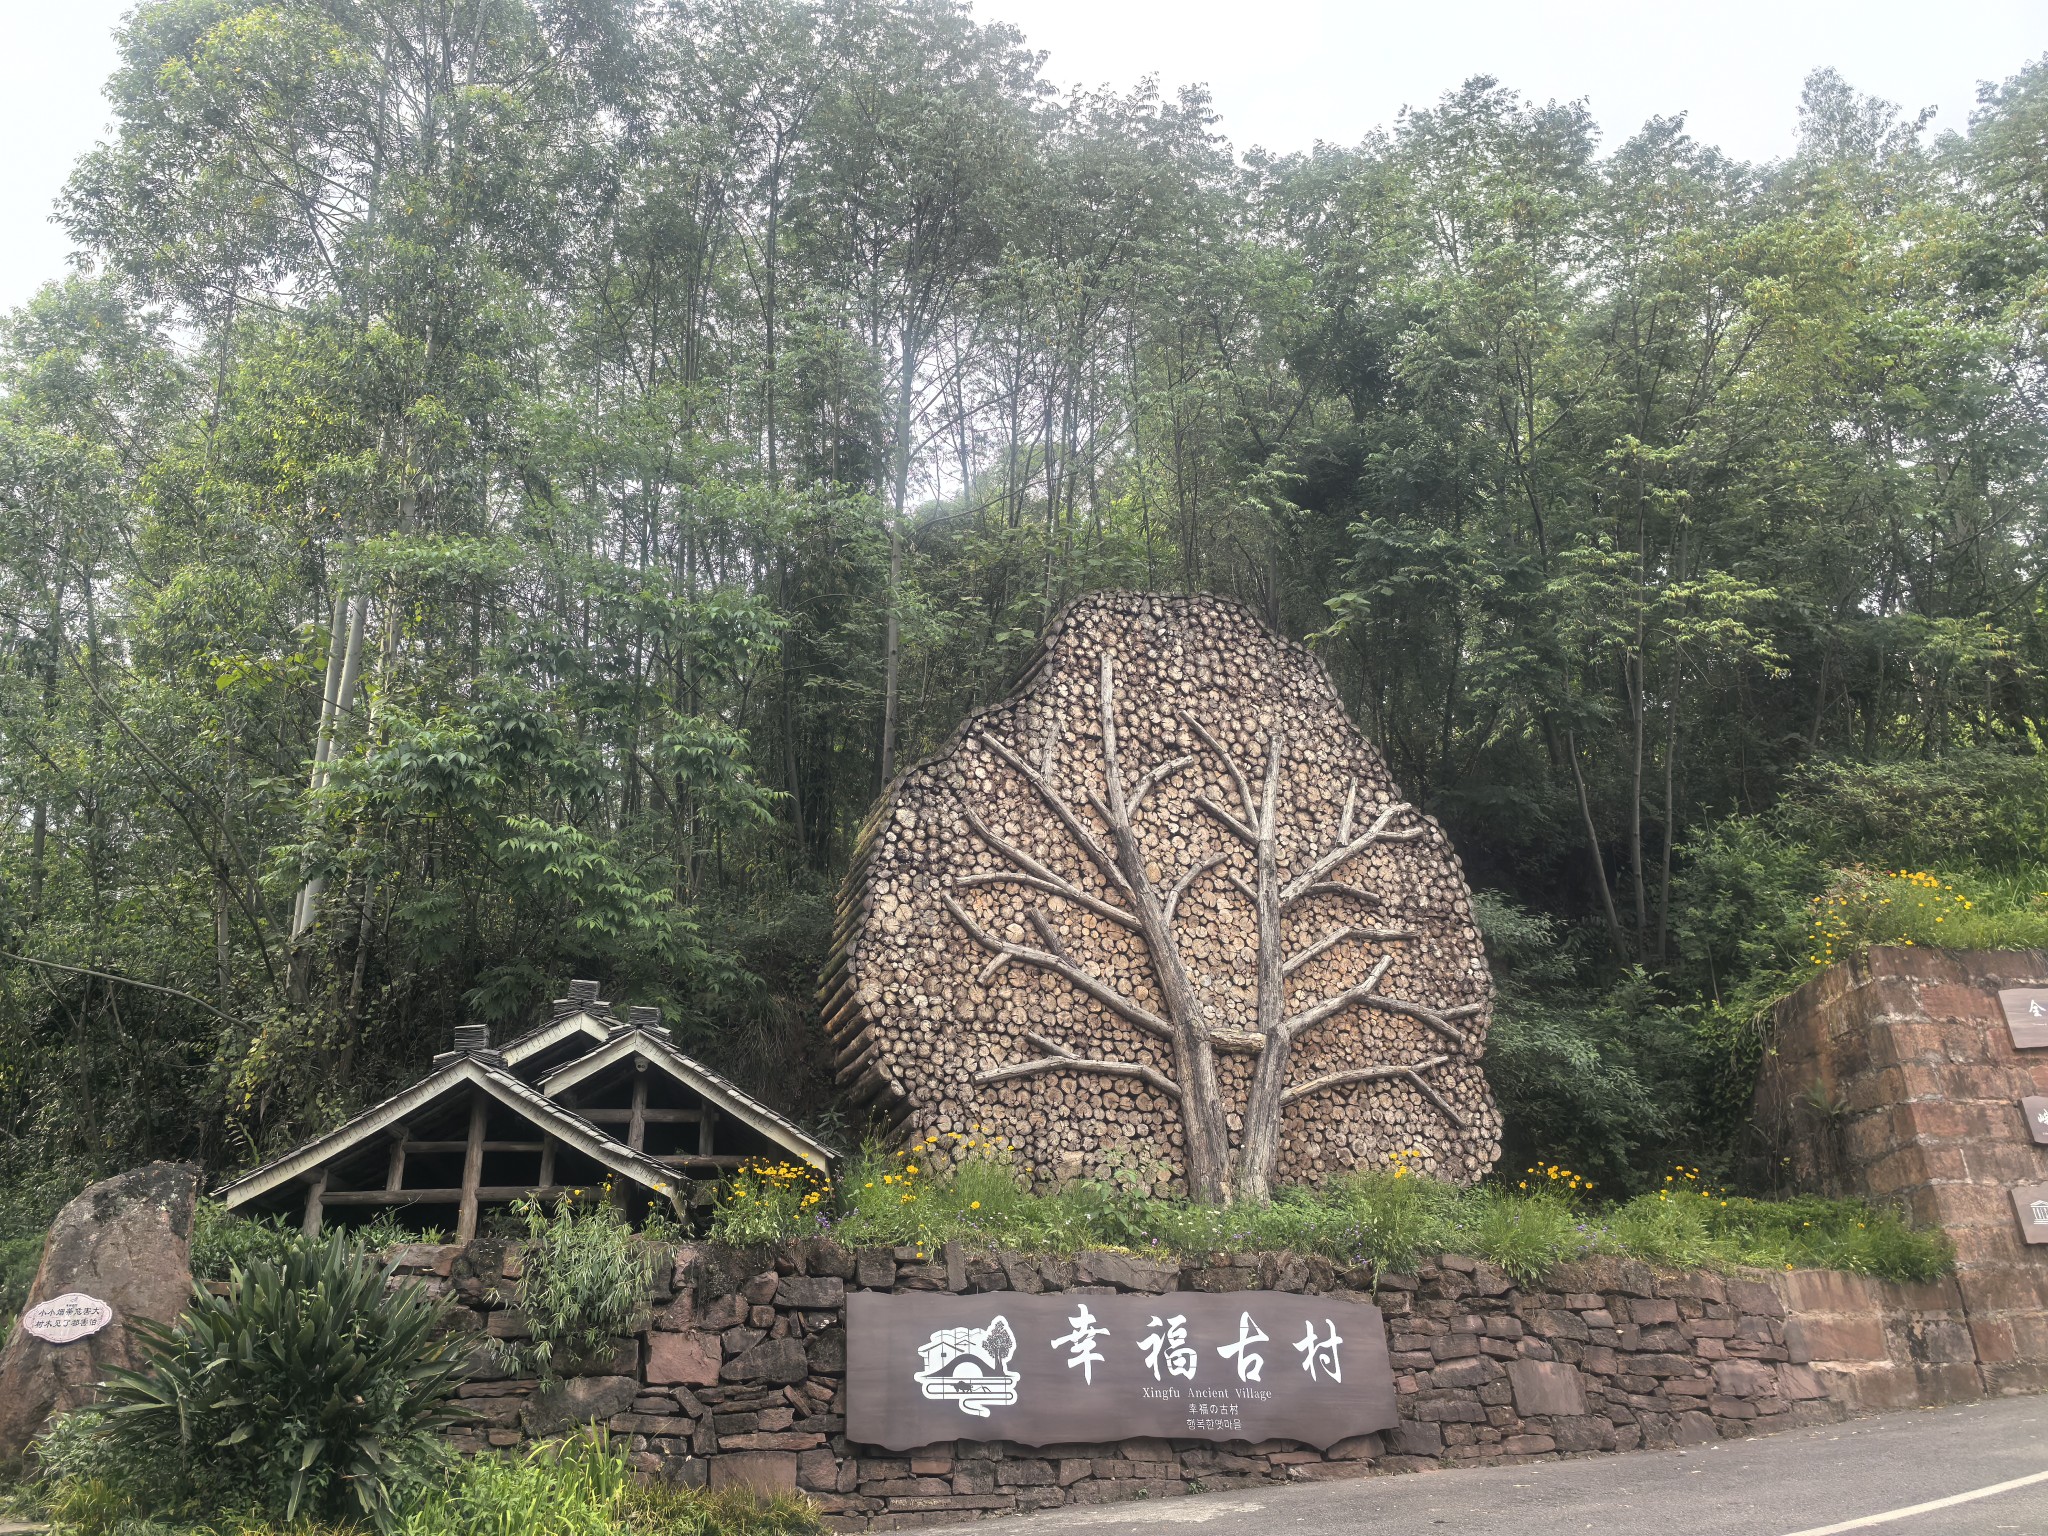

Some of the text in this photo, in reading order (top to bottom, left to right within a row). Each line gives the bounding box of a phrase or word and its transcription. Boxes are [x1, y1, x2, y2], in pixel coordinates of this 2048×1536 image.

[1051, 1303, 1344, 1386] 幸福古村
[1142, 1387, 1272, 1402] Xingfu Ancient Village
[1188, 1403, 1239, 1415] 幸福の古村
